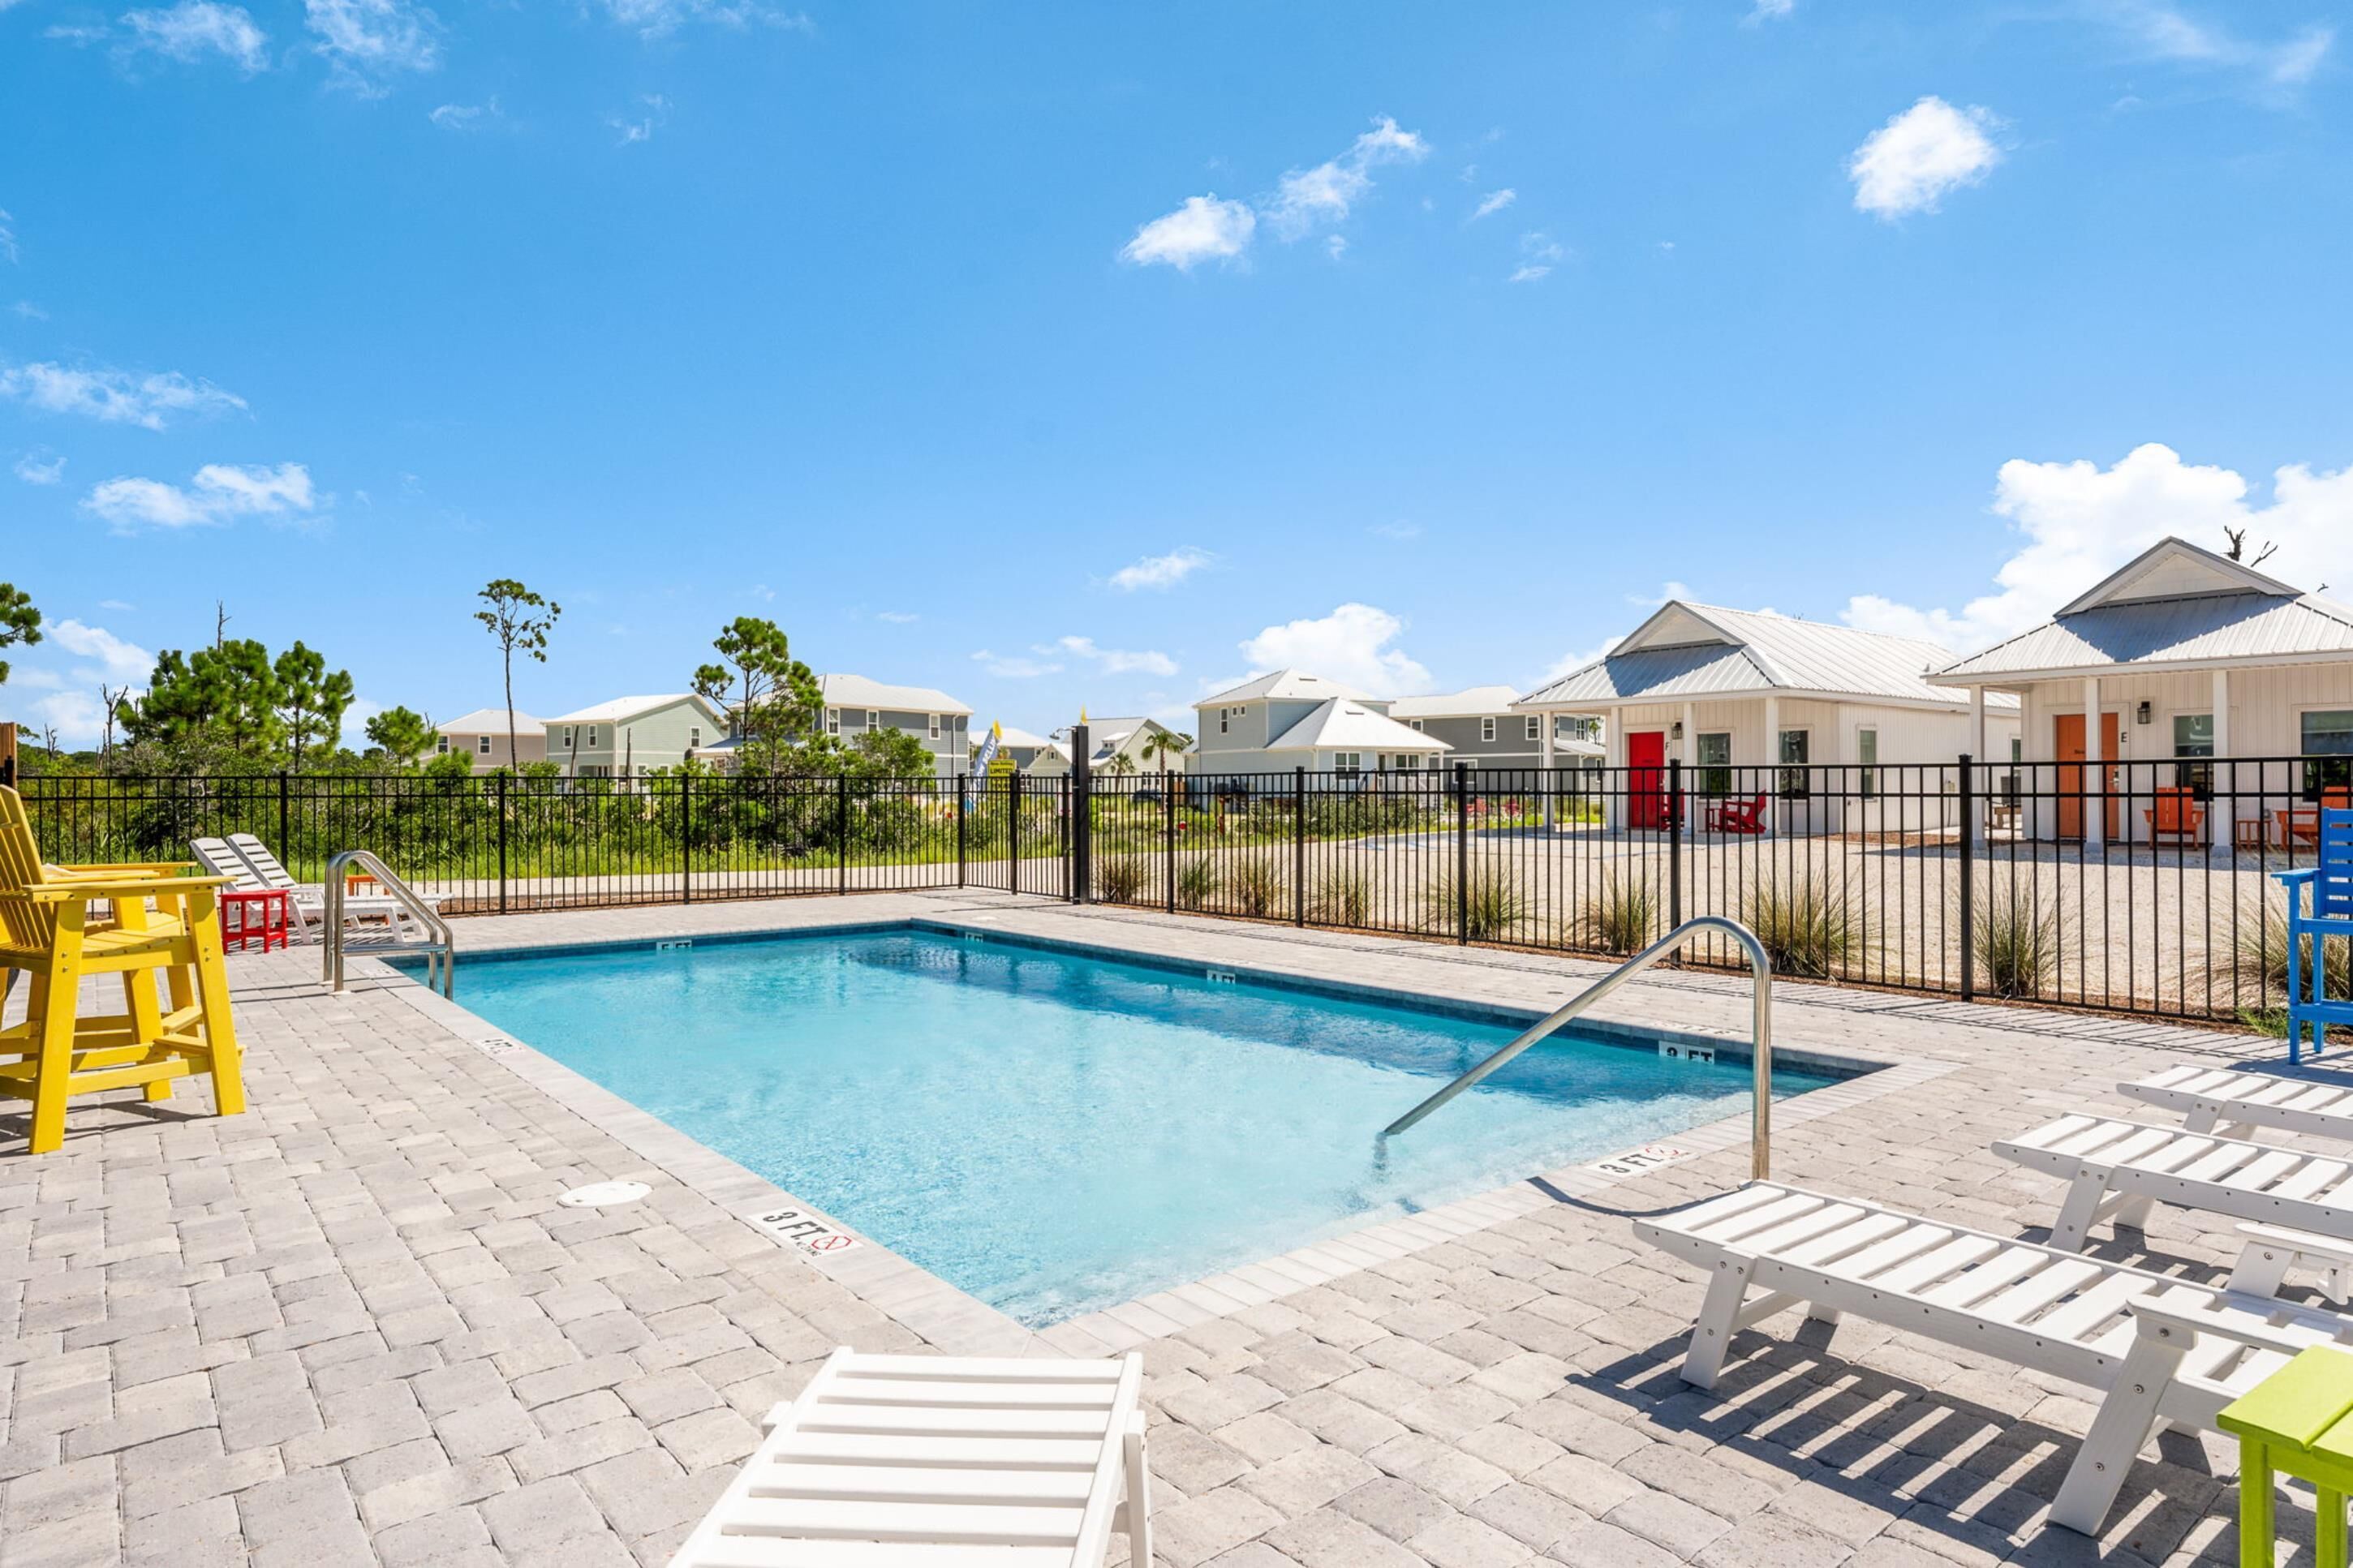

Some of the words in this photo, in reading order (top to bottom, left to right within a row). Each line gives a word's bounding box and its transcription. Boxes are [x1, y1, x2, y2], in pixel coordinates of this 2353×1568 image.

[2121, 732, 2128, 743] E
[1598, 1164, 1631, 1174] 3
[763, 1211, 798, 1222] 3
